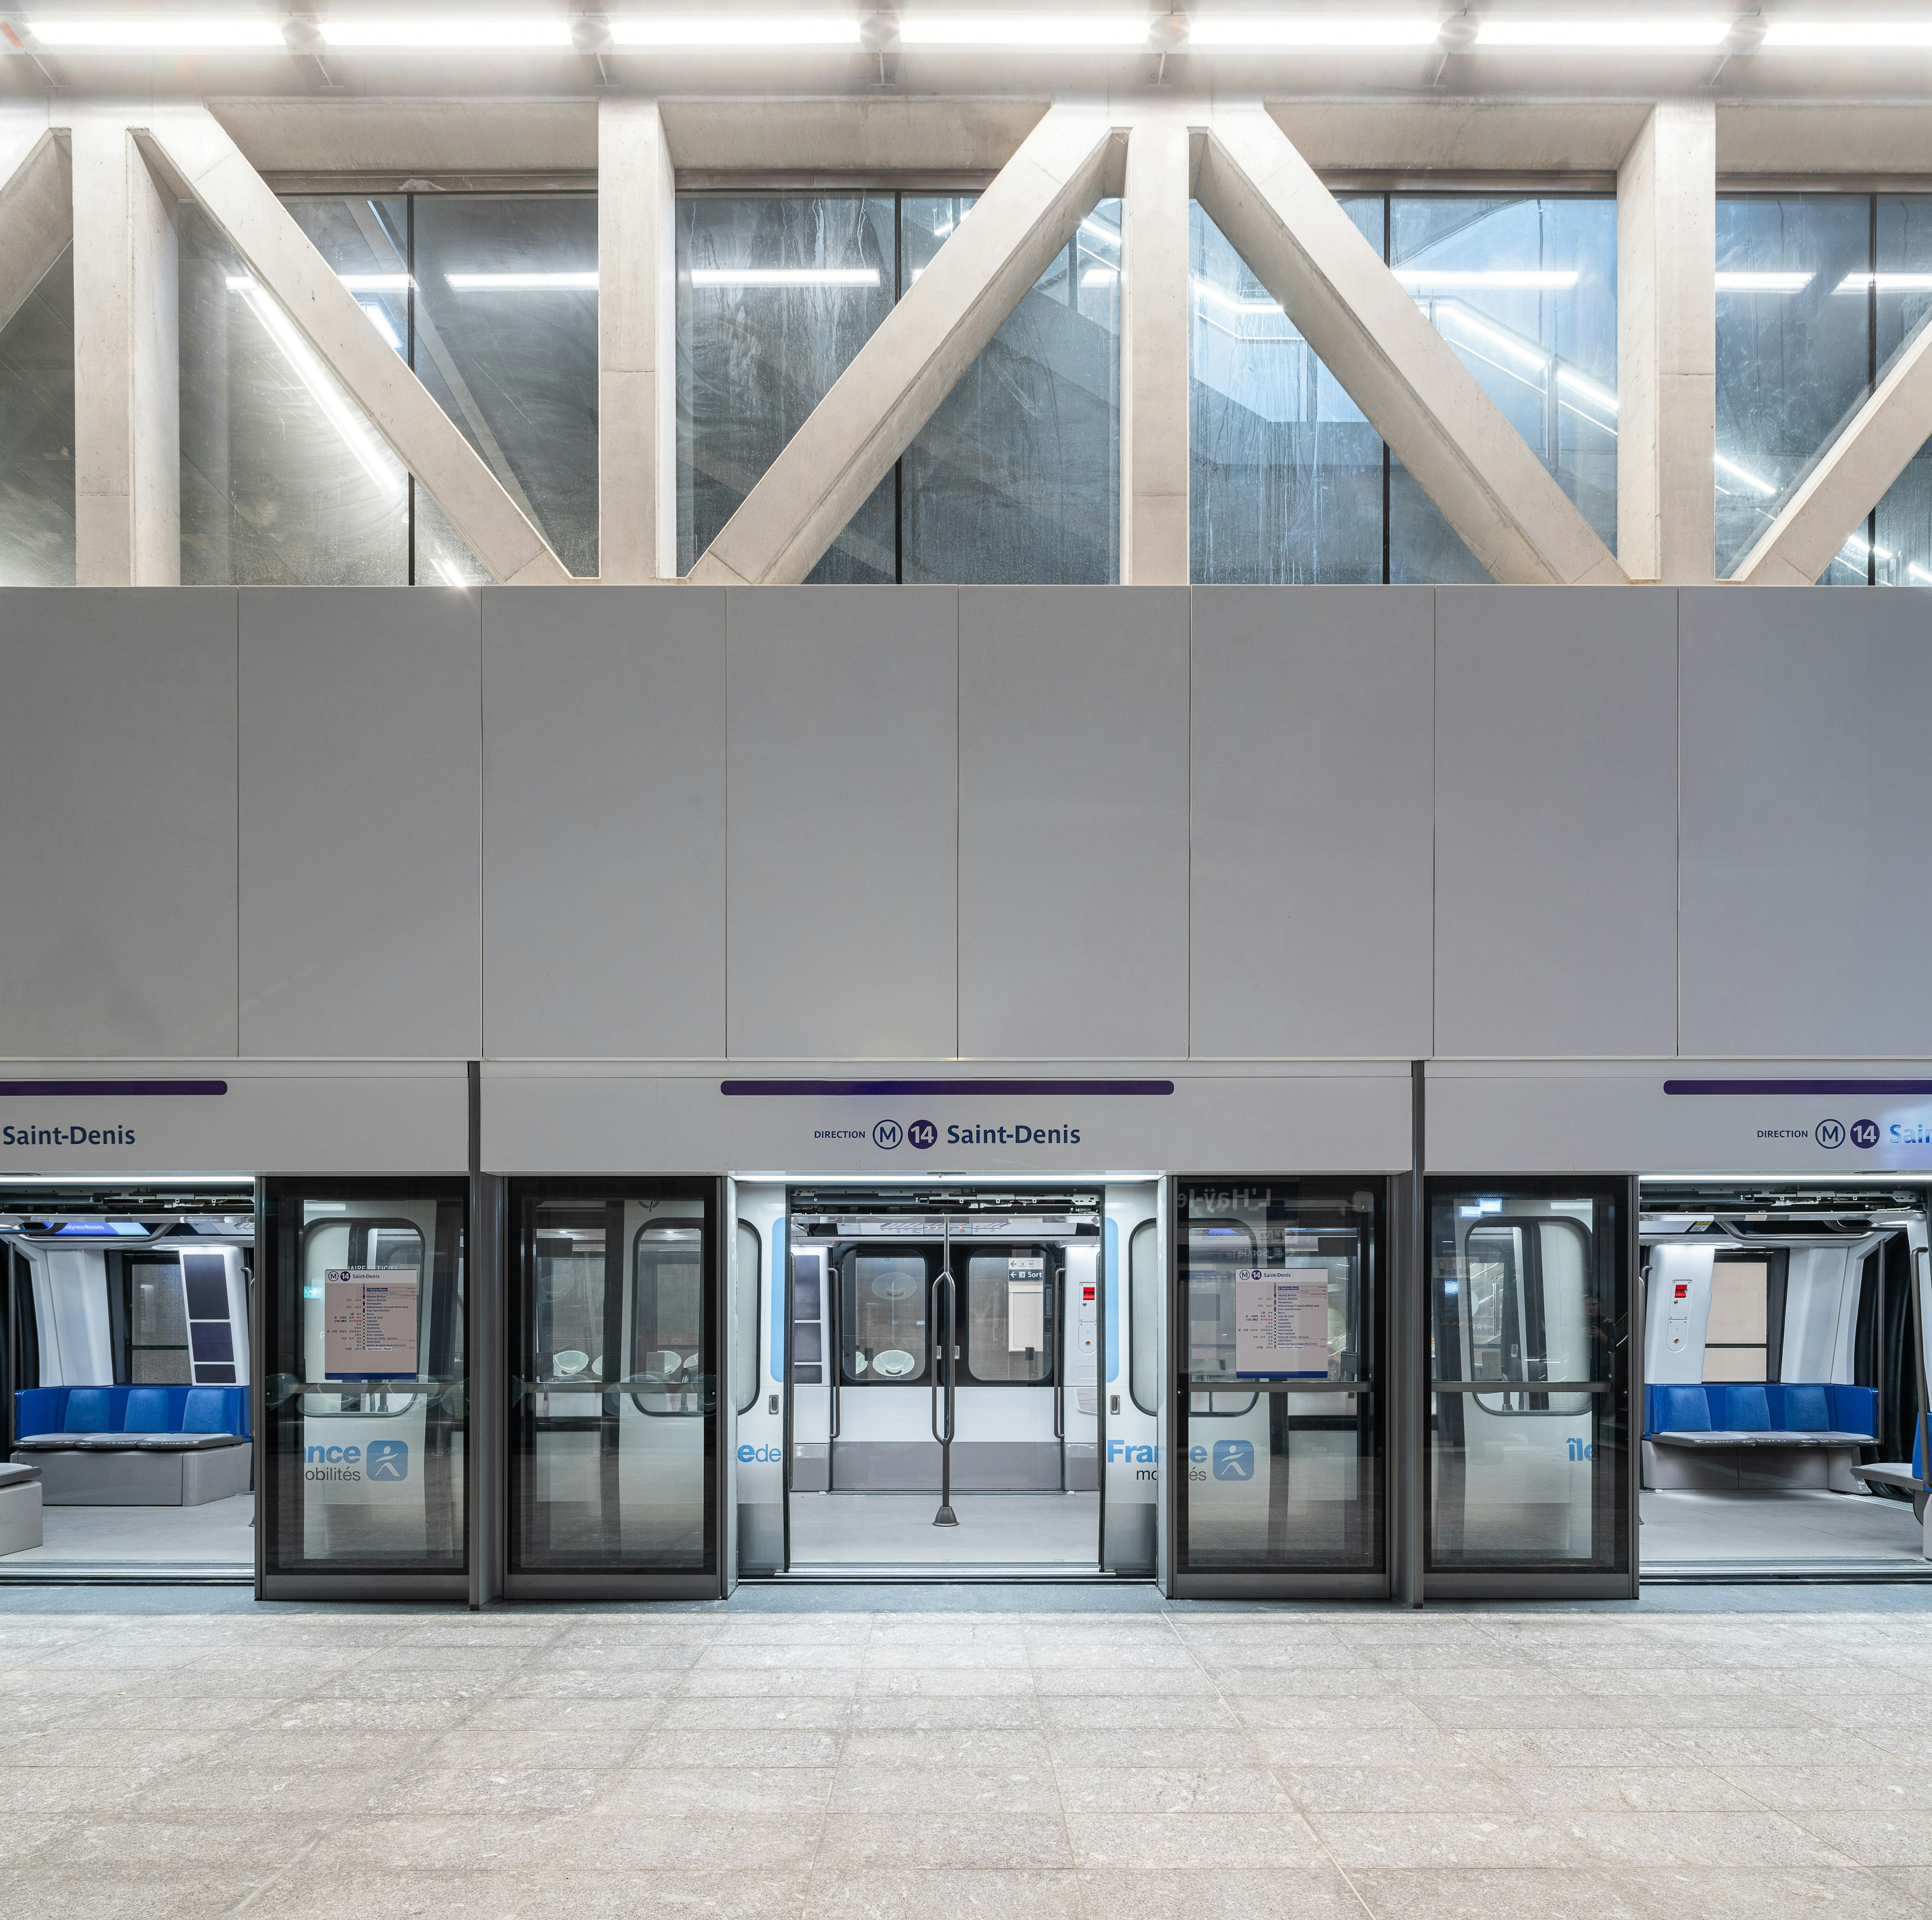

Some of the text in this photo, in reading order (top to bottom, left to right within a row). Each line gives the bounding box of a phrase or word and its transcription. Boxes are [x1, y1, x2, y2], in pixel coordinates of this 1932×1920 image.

[2, 1125, 136, 1145] Saint-Denis
[911, 1126, 934, 1143] 14
[947, 1124, 1081, 1144] Saint-Denis
[1853, 1125, 1877, 1143] 14
